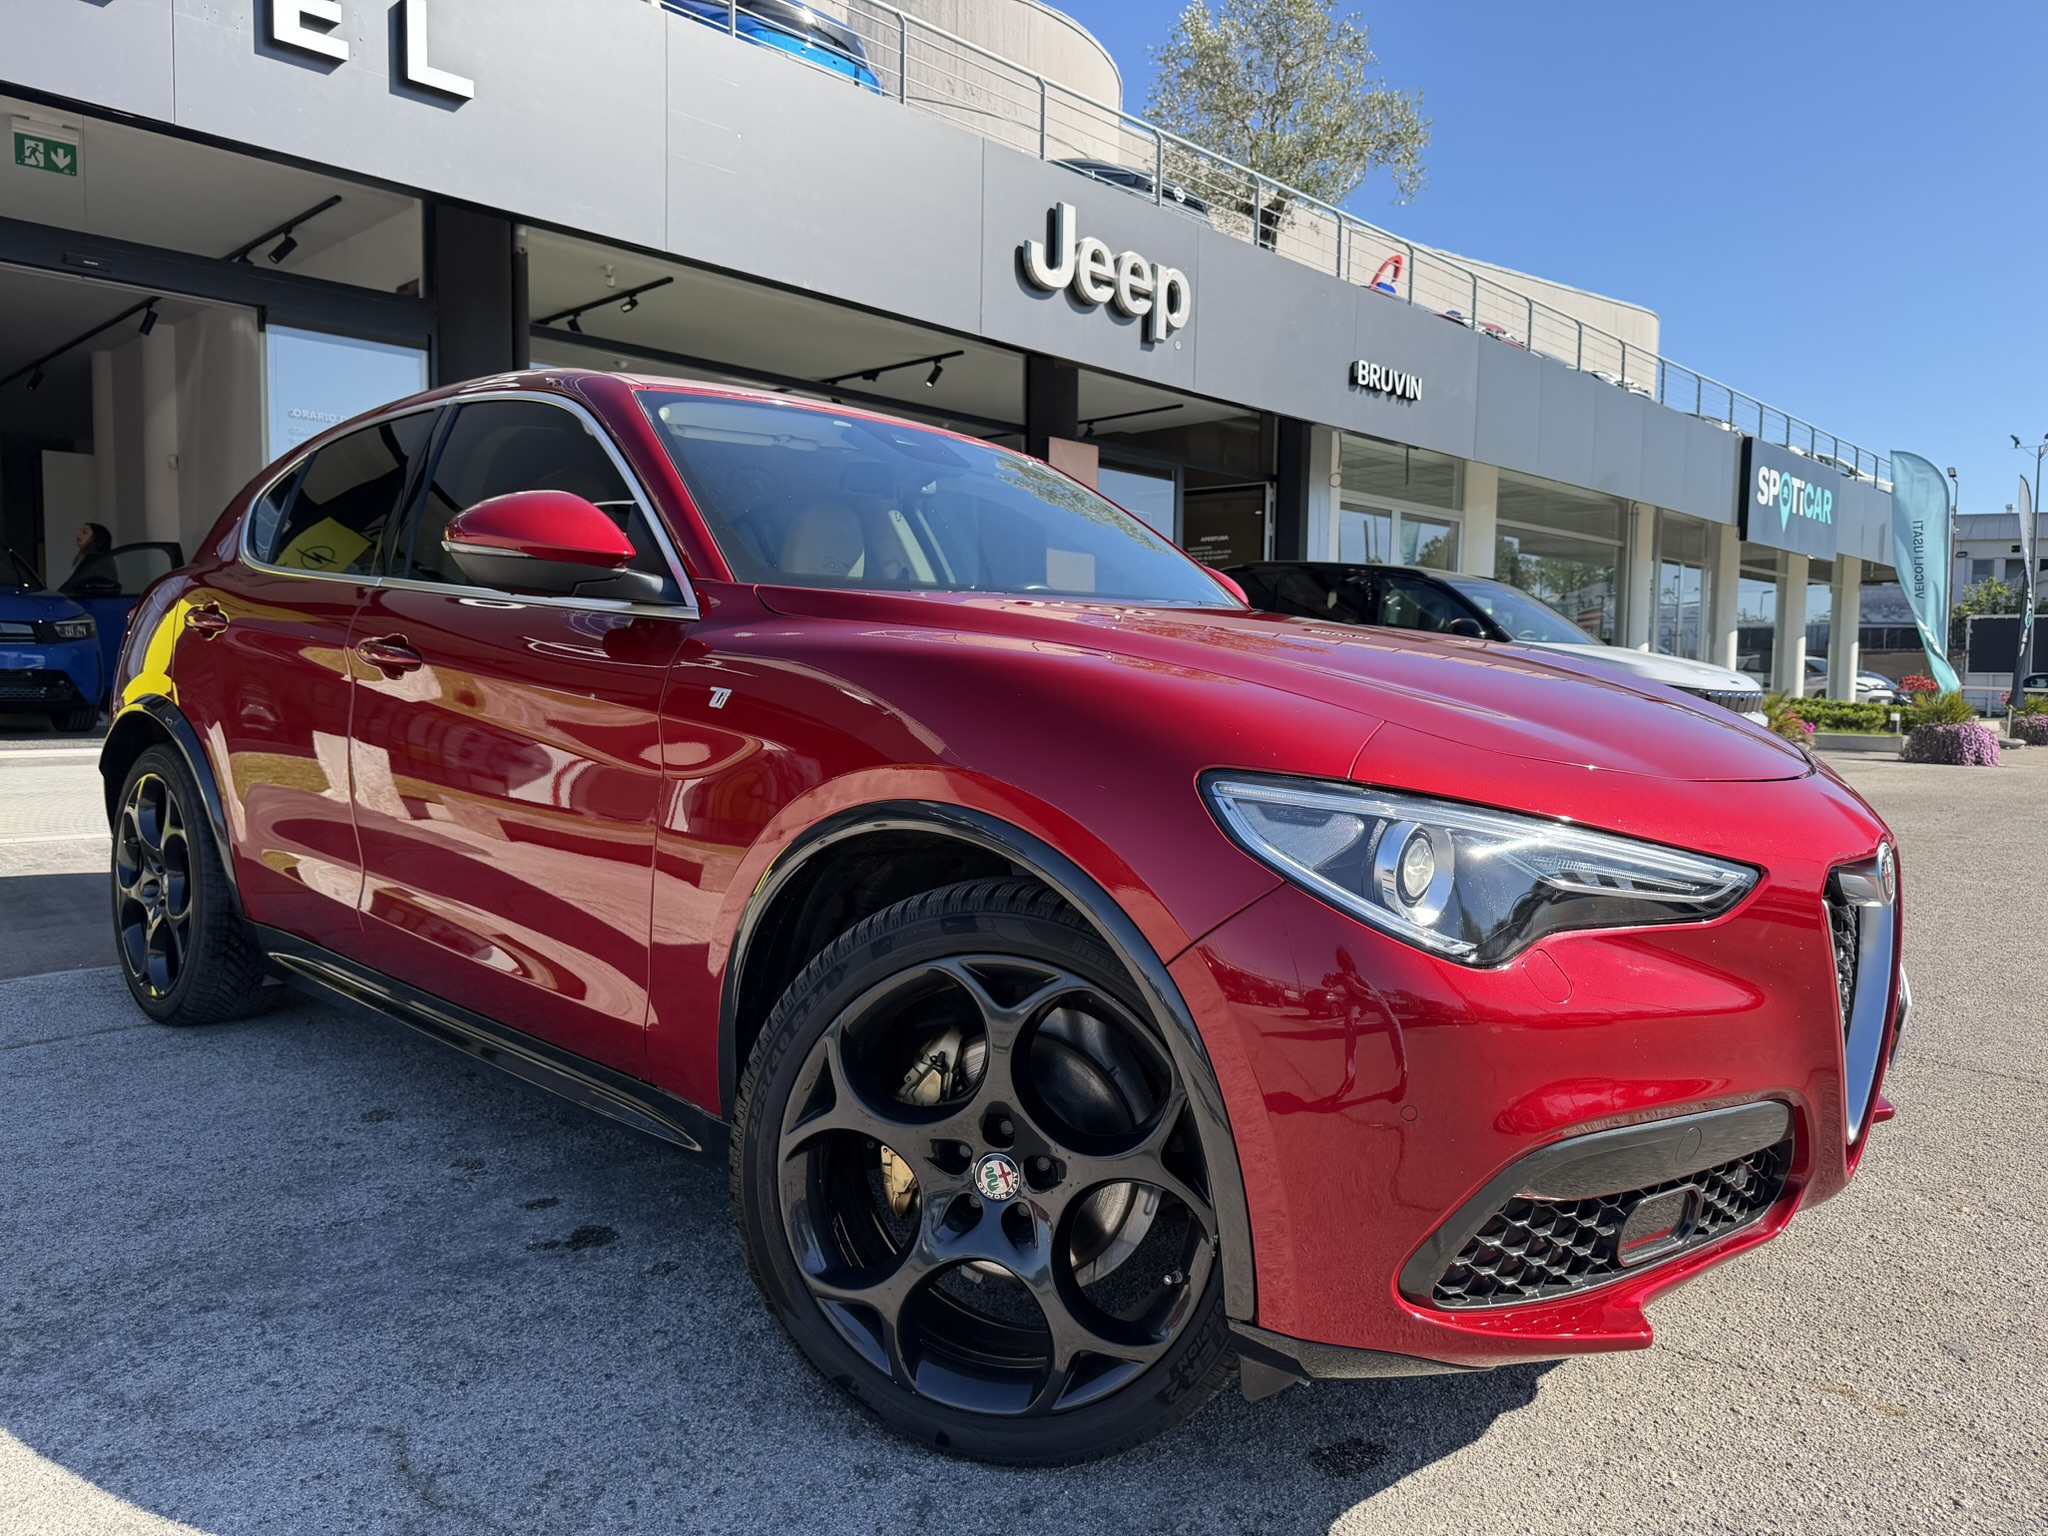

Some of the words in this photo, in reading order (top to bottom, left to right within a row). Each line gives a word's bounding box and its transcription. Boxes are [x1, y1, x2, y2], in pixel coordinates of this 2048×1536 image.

[1023, 201, 1192, 344] Jeep
[1357, 359, 1422, 401] BRUVIN
[1177, 1298, 1223, 1373] ORPION
